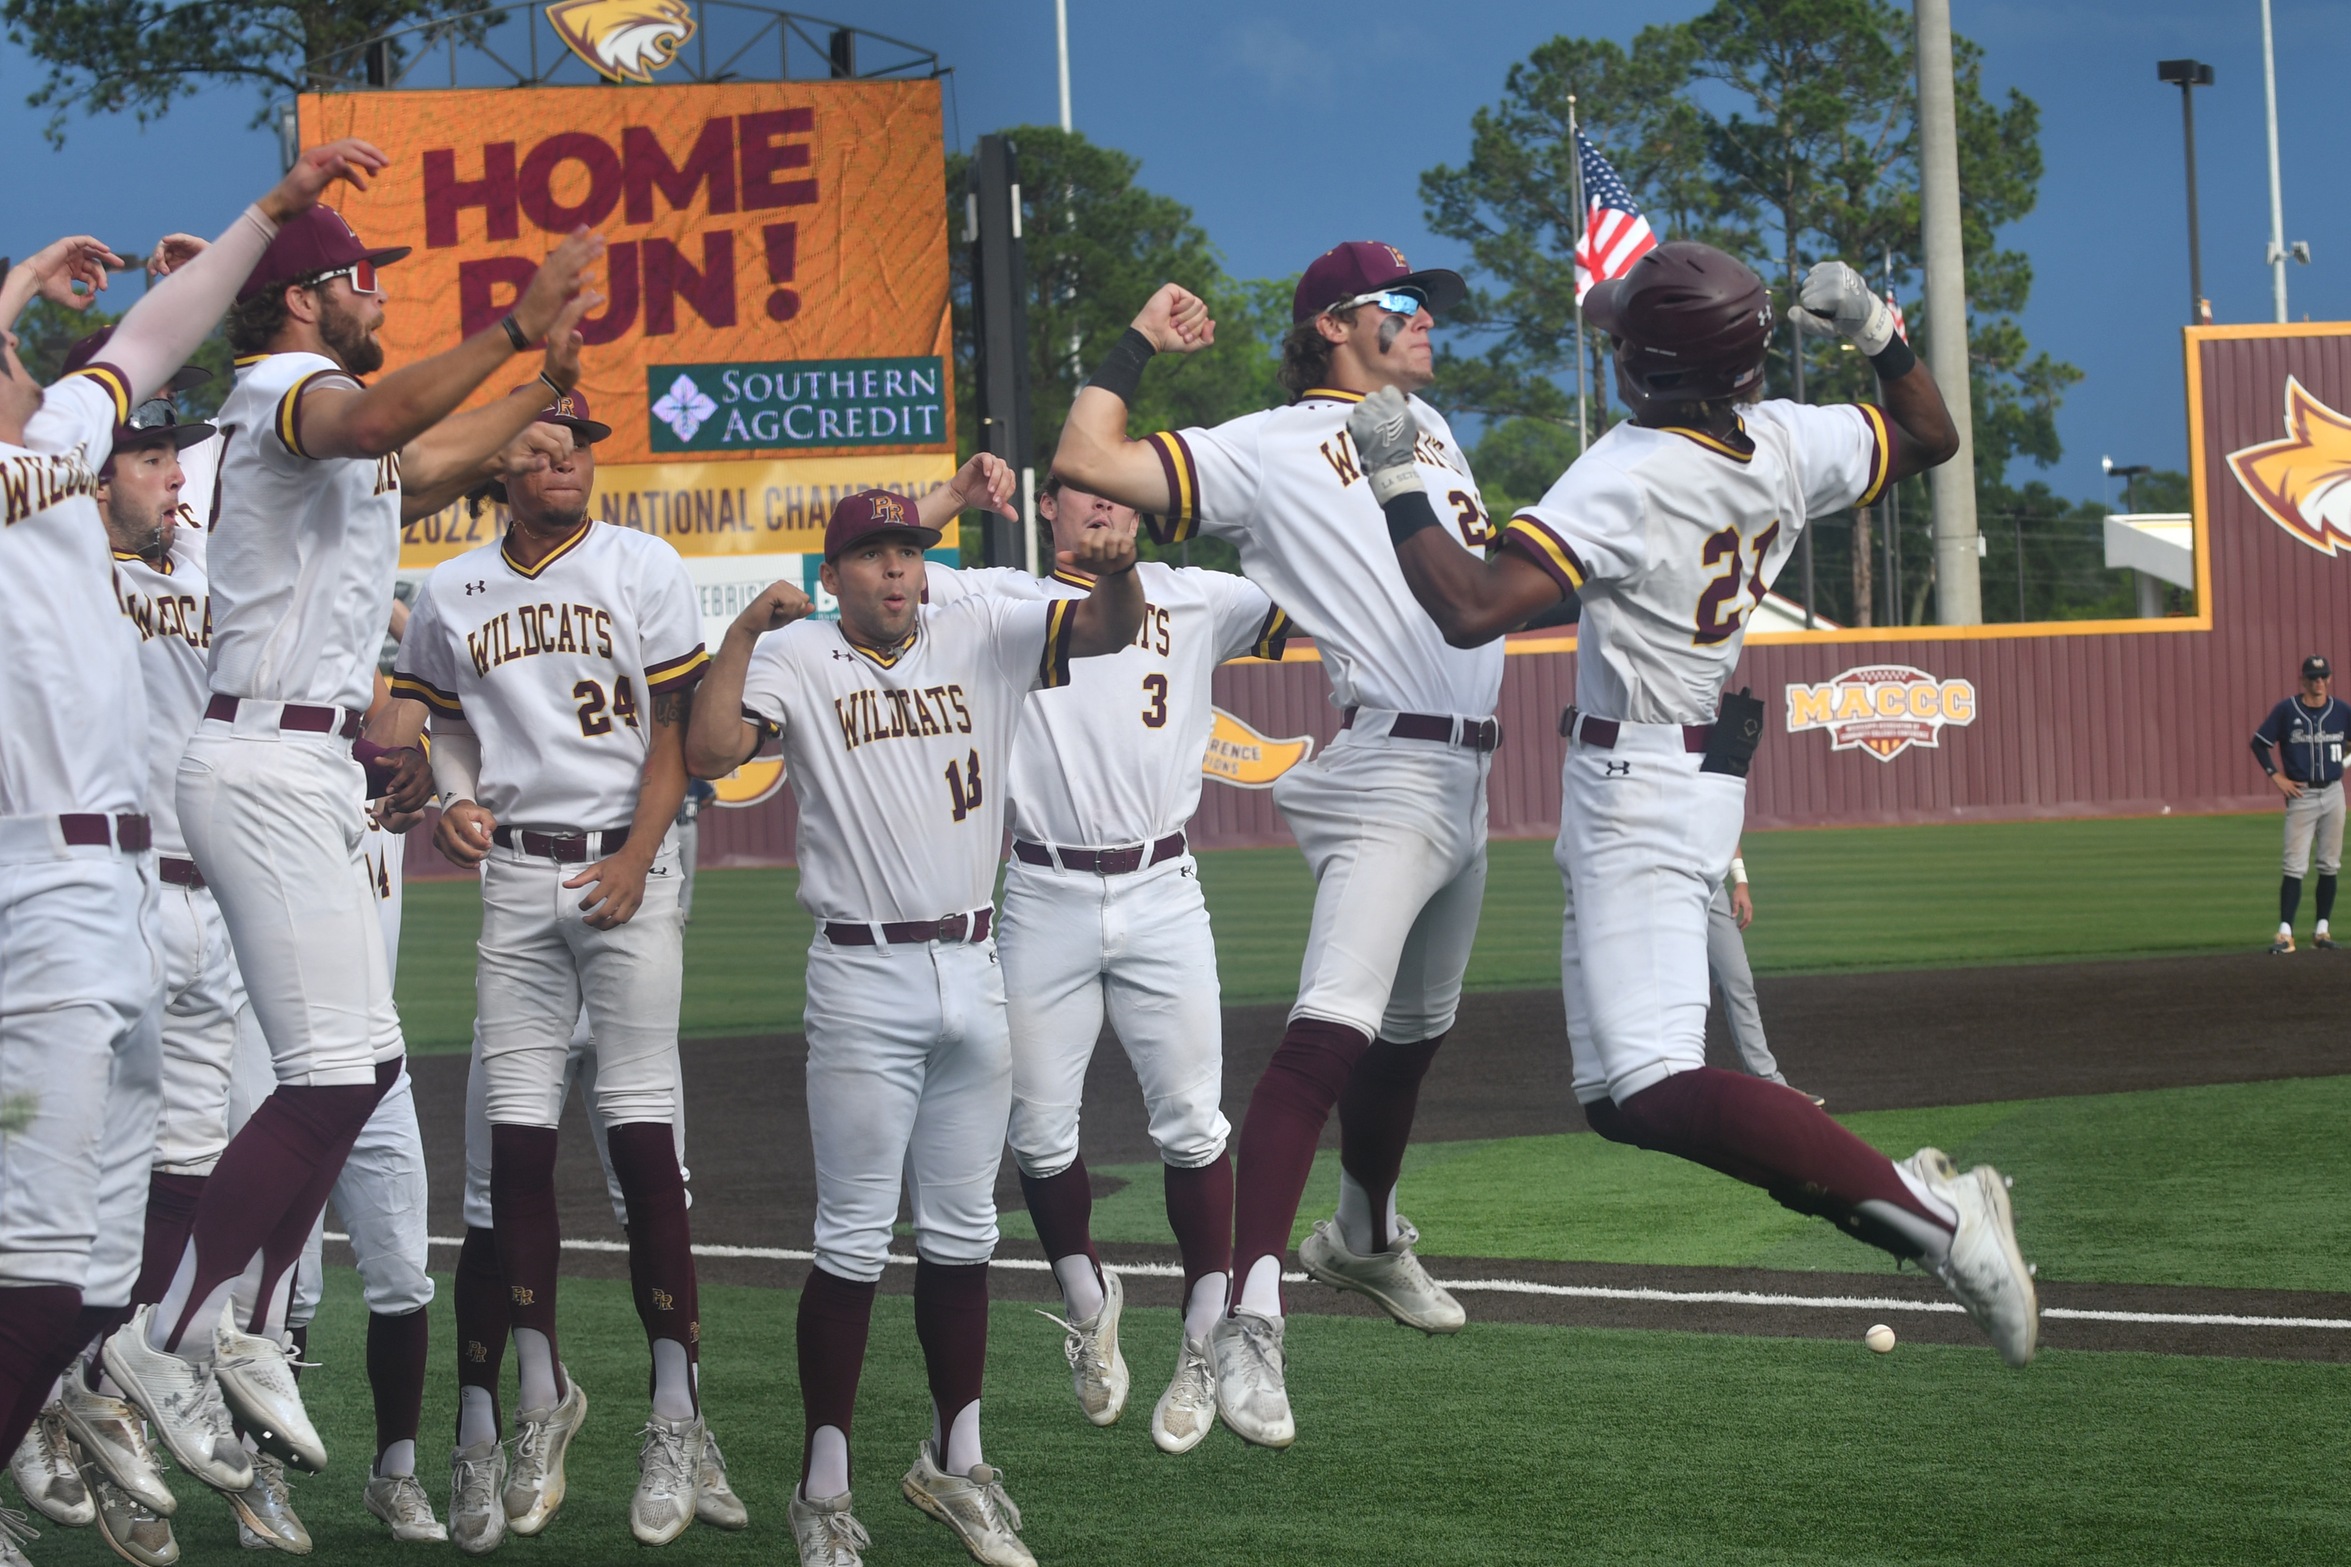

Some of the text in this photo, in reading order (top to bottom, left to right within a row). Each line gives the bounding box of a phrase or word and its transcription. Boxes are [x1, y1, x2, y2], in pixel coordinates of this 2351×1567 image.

[422, 107, 818, 249] HOME
[459, 222, 801, 351] RUN!
[721, 368, 936, 404] SOUTHERN
[600, 485, 757, 535] NATIONAL
[869, 495, 909, 526] PR
[1691, 518, 1780, 649] 21
[467, 602, 613, 680] WILDCATS
[573, 674, 640, 738] 24
[834, 684, 973, 752] WILDCATS
[1142, 672, 1169, 729] 3
[1790, 683, 1973, 728] MACCC
[2330, 742, 2343, 763] 11
